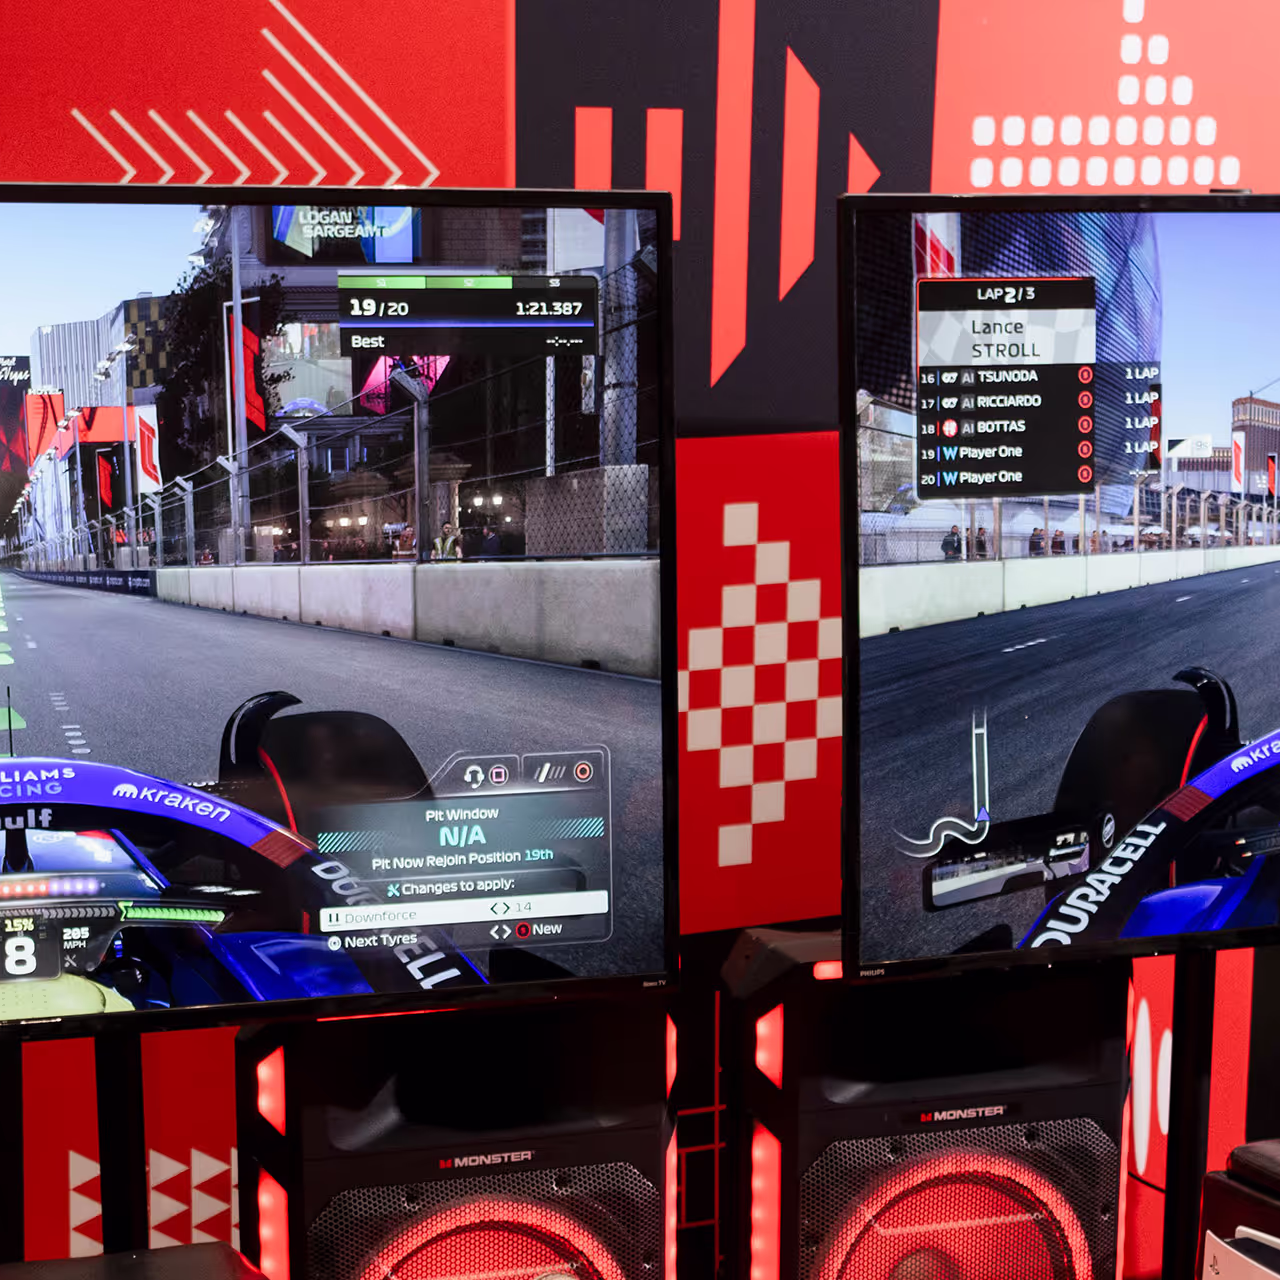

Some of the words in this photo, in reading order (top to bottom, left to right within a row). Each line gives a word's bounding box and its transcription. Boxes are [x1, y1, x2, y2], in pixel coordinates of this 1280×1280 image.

[299, 210, 352, 224] LOGAN
[977, 288, 1004, 300] LAP
[516, 301, 582, 316] 1:21.387
[972, 320, 1024, 334] Lance
[351, 335, 385, 348] Best
[972, 343, 1040, 358] STROLL
[921, 374, 935, 384] 16
[978, 370, 1039, 383] TSUNODA
[1135, 367, 1160, 379] LAP
[921, 399, 935, 410] 17
[977, 394, 1042, 408] RICCIARDO
[1135, 391, 1160, 403] LAP
[921, 424, 935, 435] 18
[977, 420, 1026, 433] BOTTAS
[1135, 416, 1160, 428] LAP
[921, 449, 935, 460] 19
[960, 446, 997, 461] Player
[998, 445, 1023, 458] One
[1135, 441, 1160, 453] LAP
[921, 474, 936, 485] 20
[960, 471, 997, 487] Player
[998, 470, 1023, 483] One
[139, 785, 232, 823] kraken
[445, 807, 500, 821] Window
[439, 825, 487, 848] N/A
[393, 856, 425, 870] Now
[426, 854, 467, 870] Rejoin
[468, 850, 522, 866] Position
[525, 849, 555, 863] 19th
[402, 880, 460, 897] Changes
[461, 880, 475, 893] to
[476, 878, 515, 894] apply:
[344, 909, 418, 925] Downforce
[515, 902, 532, 913] 14
[5, 918, 35, 933] 15%
[344, 936, 379, 948] Next
[380, 932, 419, 948] Tyres
[532, 923, 563, 936] New
[4, 936, 37, 975] 8
[63, 940, 87, 950] MPH
[934, 1105, 1004, 1121] MONSTER
[454, 1150, 532, 1168] MONSTER
